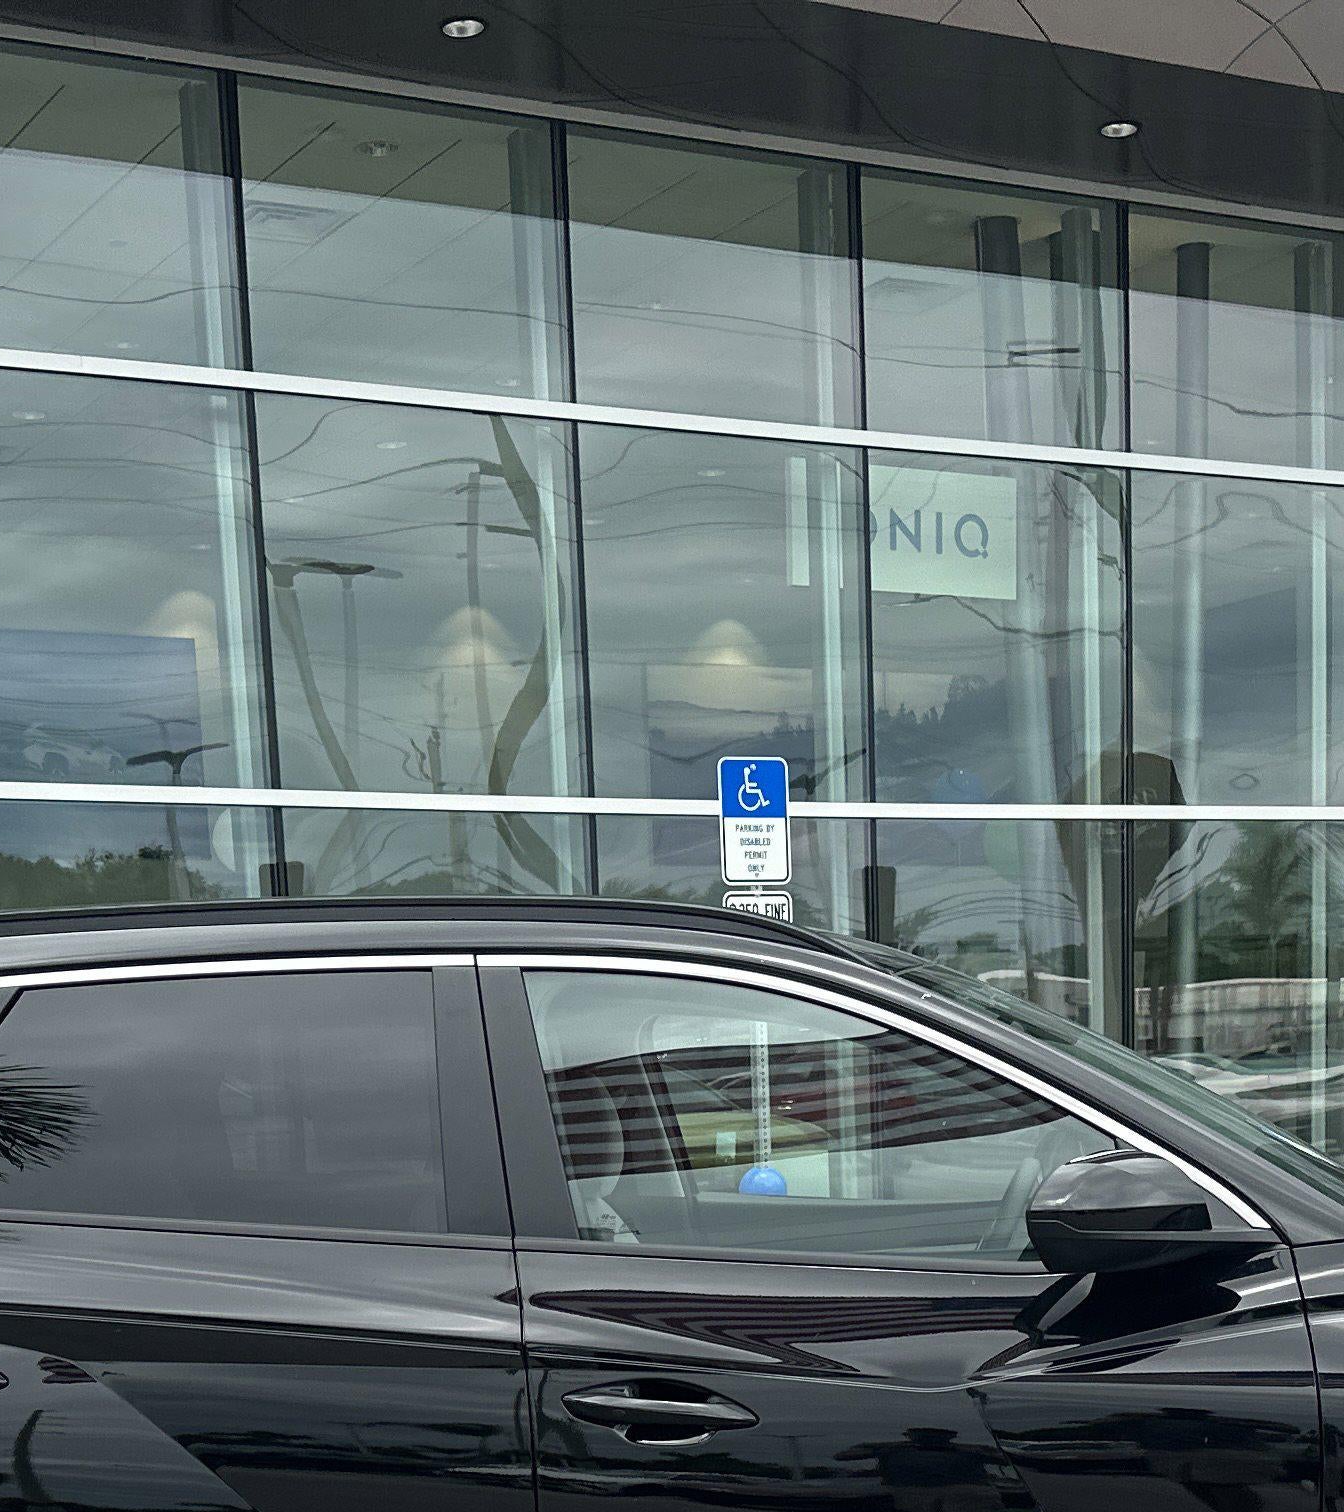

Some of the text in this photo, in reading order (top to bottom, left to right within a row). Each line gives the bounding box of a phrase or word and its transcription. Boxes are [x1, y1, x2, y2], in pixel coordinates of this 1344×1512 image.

[869, 507, 989, 559] NIQ
[736, 824, 763, 832] PARKING
[745, 851, 767, 859] PERMIT
